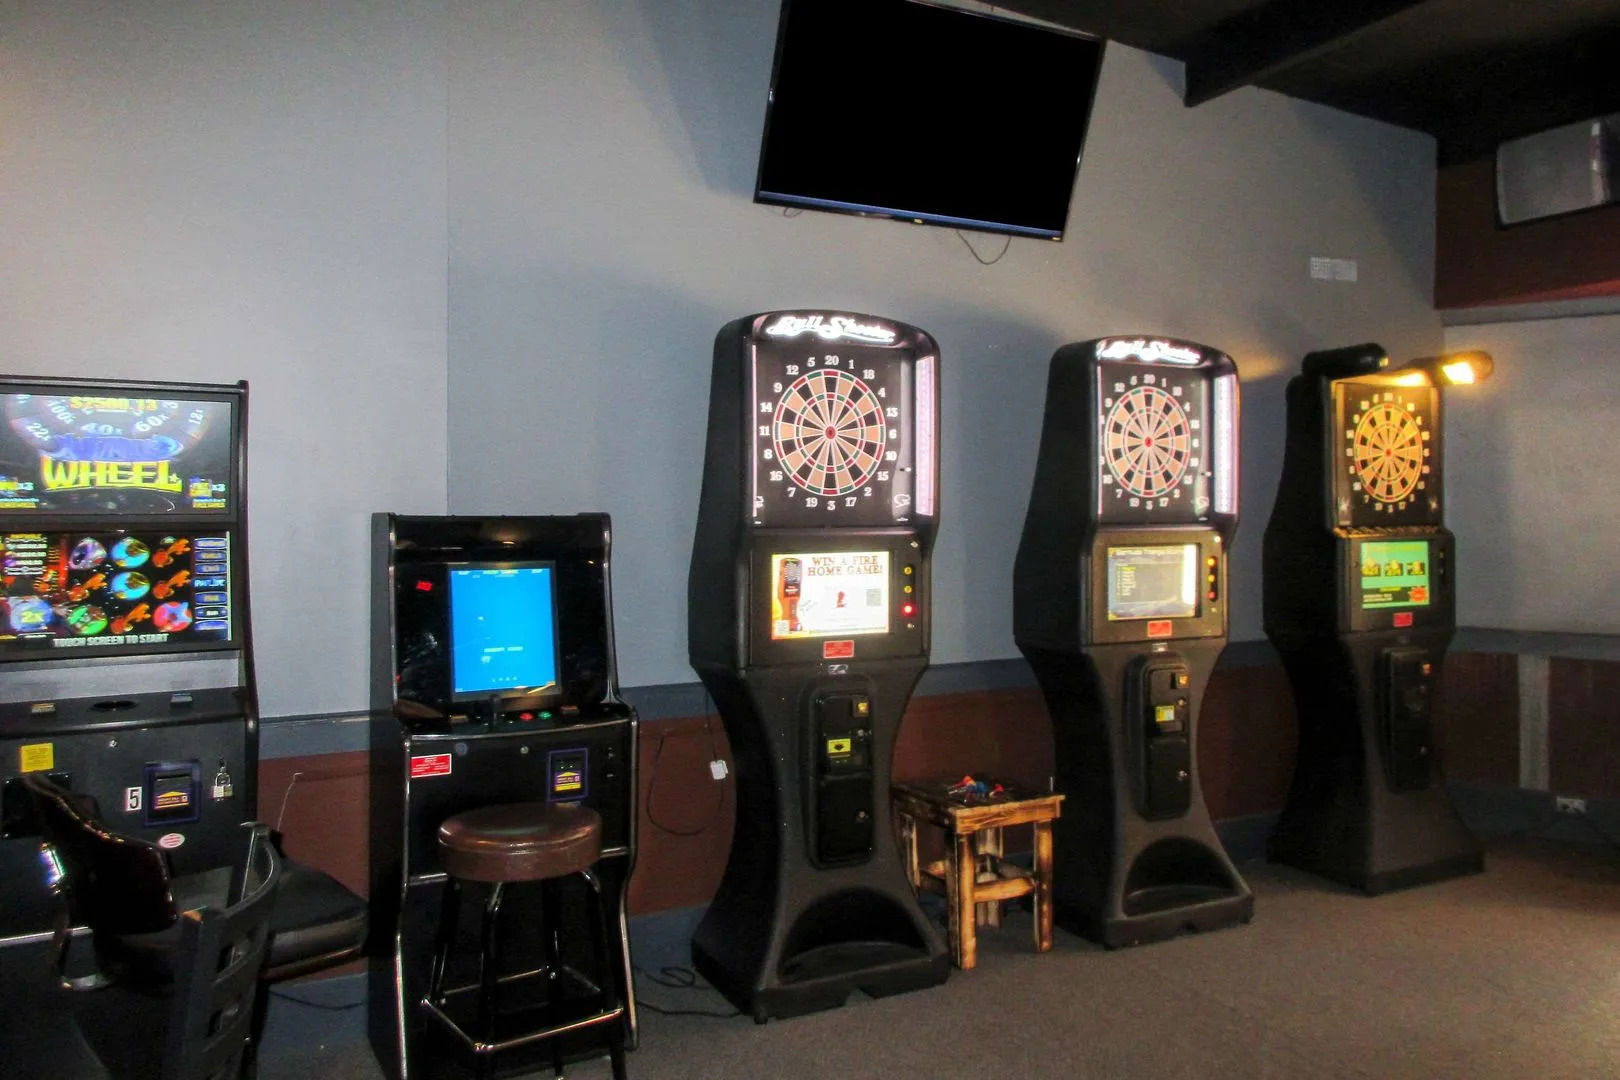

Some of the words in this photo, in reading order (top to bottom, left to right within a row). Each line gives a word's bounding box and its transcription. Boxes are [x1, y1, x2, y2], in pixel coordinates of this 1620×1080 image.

[807, 357, 815, 367] 5
[824, 355, 839, 365] 20
[848, 359, 854, 369] 1
[786, 365, 799, 376] 12
[863, 369, 875, 379] 18
[774, 383, 783, 392] 9
[878, 387, 886, 397] 4
[760, 402, 773, 413] 14
[759, 426, 770, 436] 11
[889, 429, 897, 439] 6
[764, 449, 772, 459] 8
[885, 451, 897, 461] 10
[41, 455, 182, 493] WHEEL
[769, 470, 783, 481] 16
[877, 471, 889, 481] 15
[787, 487, 796, 497] 7
[864, 487, 872, 496] 2
[805, 497, 818, 507] 19
[845, 496, 857, 507] 17
[812, 557, 834, 566] WIN
[853, 555, 878, 565] FIRE
[808, 566, 842, 576] HOME
[87, 635, 124, 647] SCREEN
[139, 633, 169, 643] START
[130, 789, 139, 809] 5
